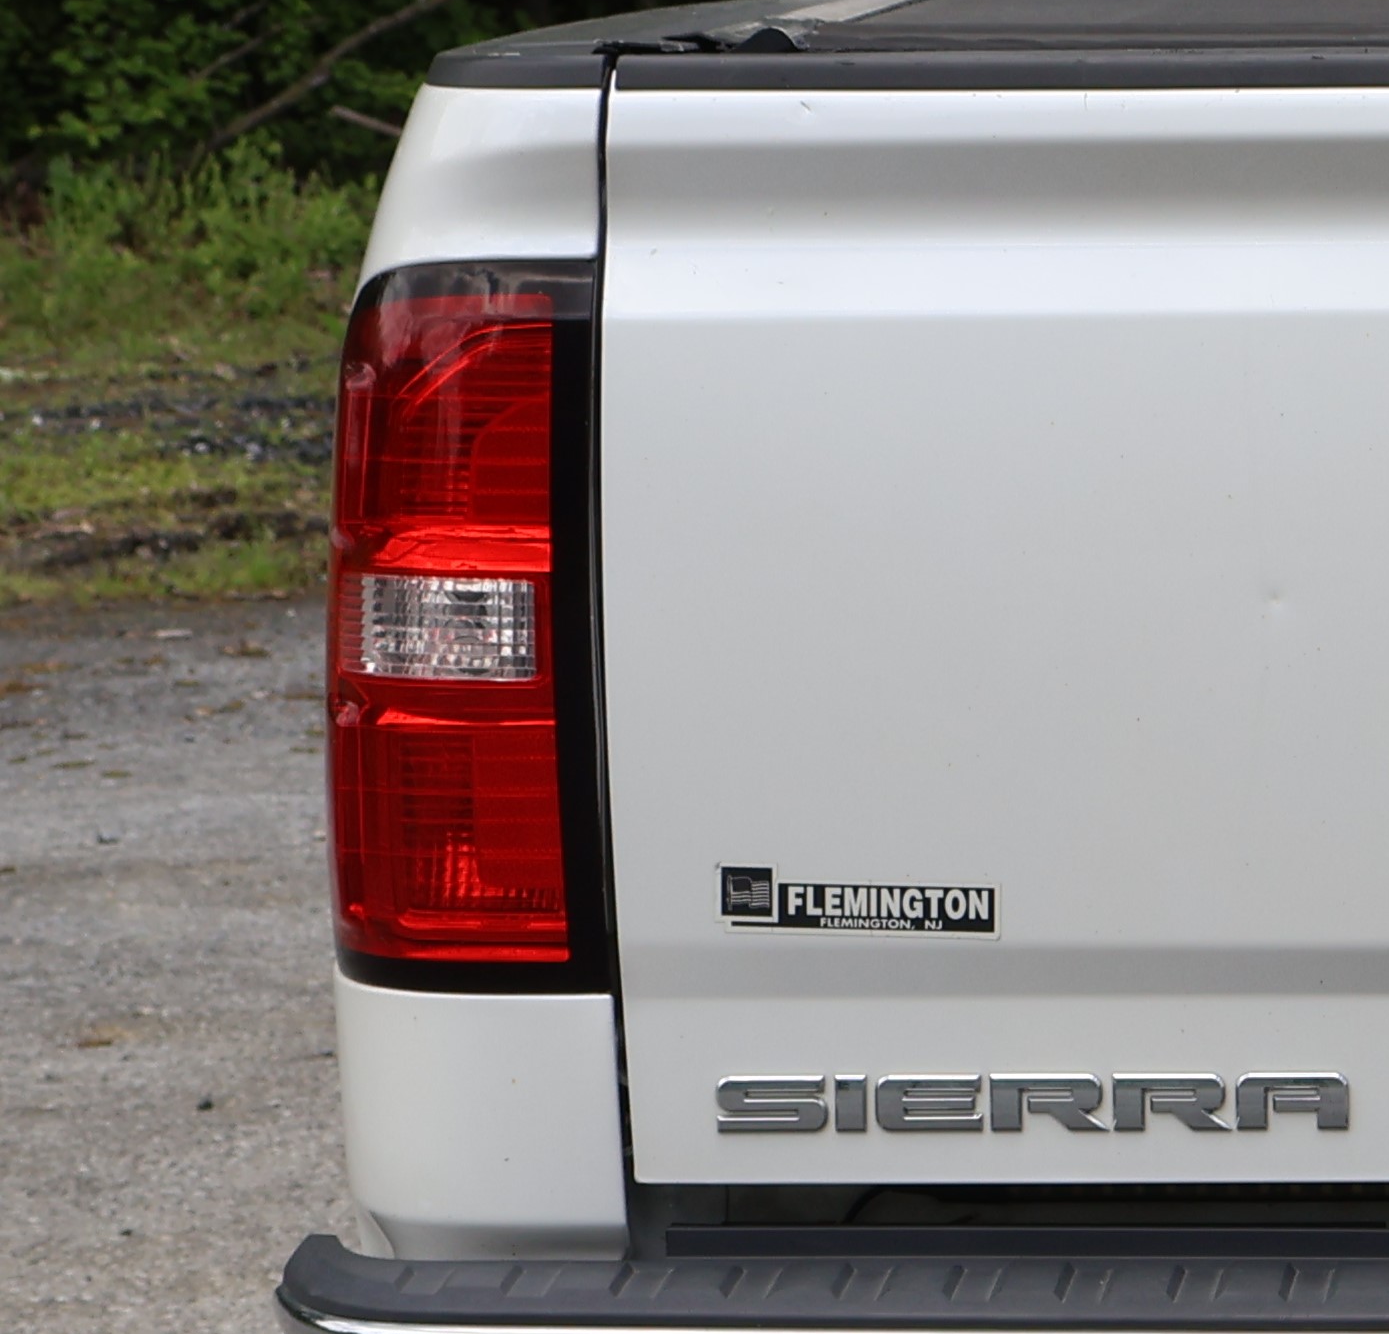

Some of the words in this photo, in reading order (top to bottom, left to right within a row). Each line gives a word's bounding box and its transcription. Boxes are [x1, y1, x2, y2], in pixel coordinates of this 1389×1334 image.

[787, 885, 989, 920] FLEMINGTON
[820, 916, 916, 930] FLEMINGTON,
[924, 920, 943, 930] NJ
[715, 1072, 1350, 1132] SIERRA
